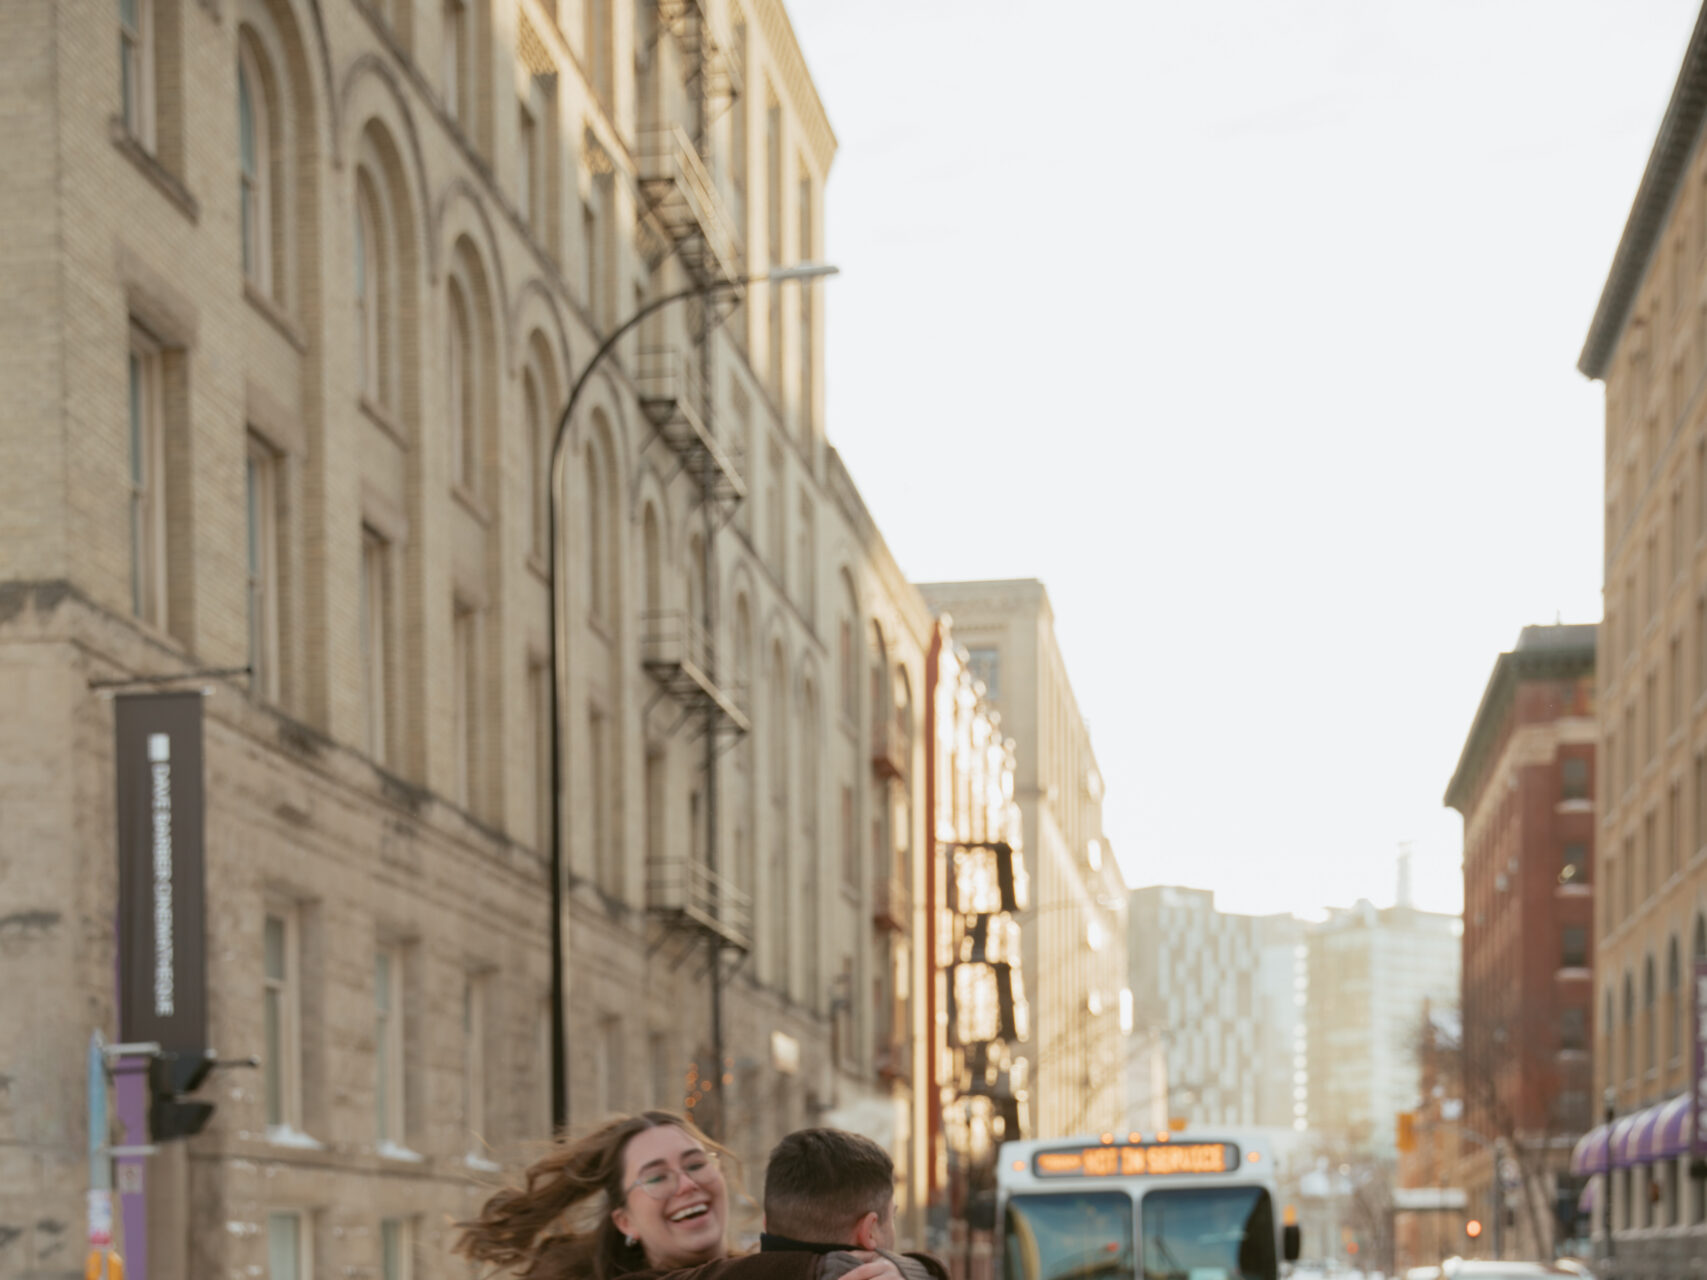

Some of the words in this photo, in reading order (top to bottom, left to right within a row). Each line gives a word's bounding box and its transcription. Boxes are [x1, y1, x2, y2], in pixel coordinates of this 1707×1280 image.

[152, 762, 171, 808] DAVE
[153, 810, 172, 878] BARBER
[154, 880, 174, 1016] CINEMATHEQUE
